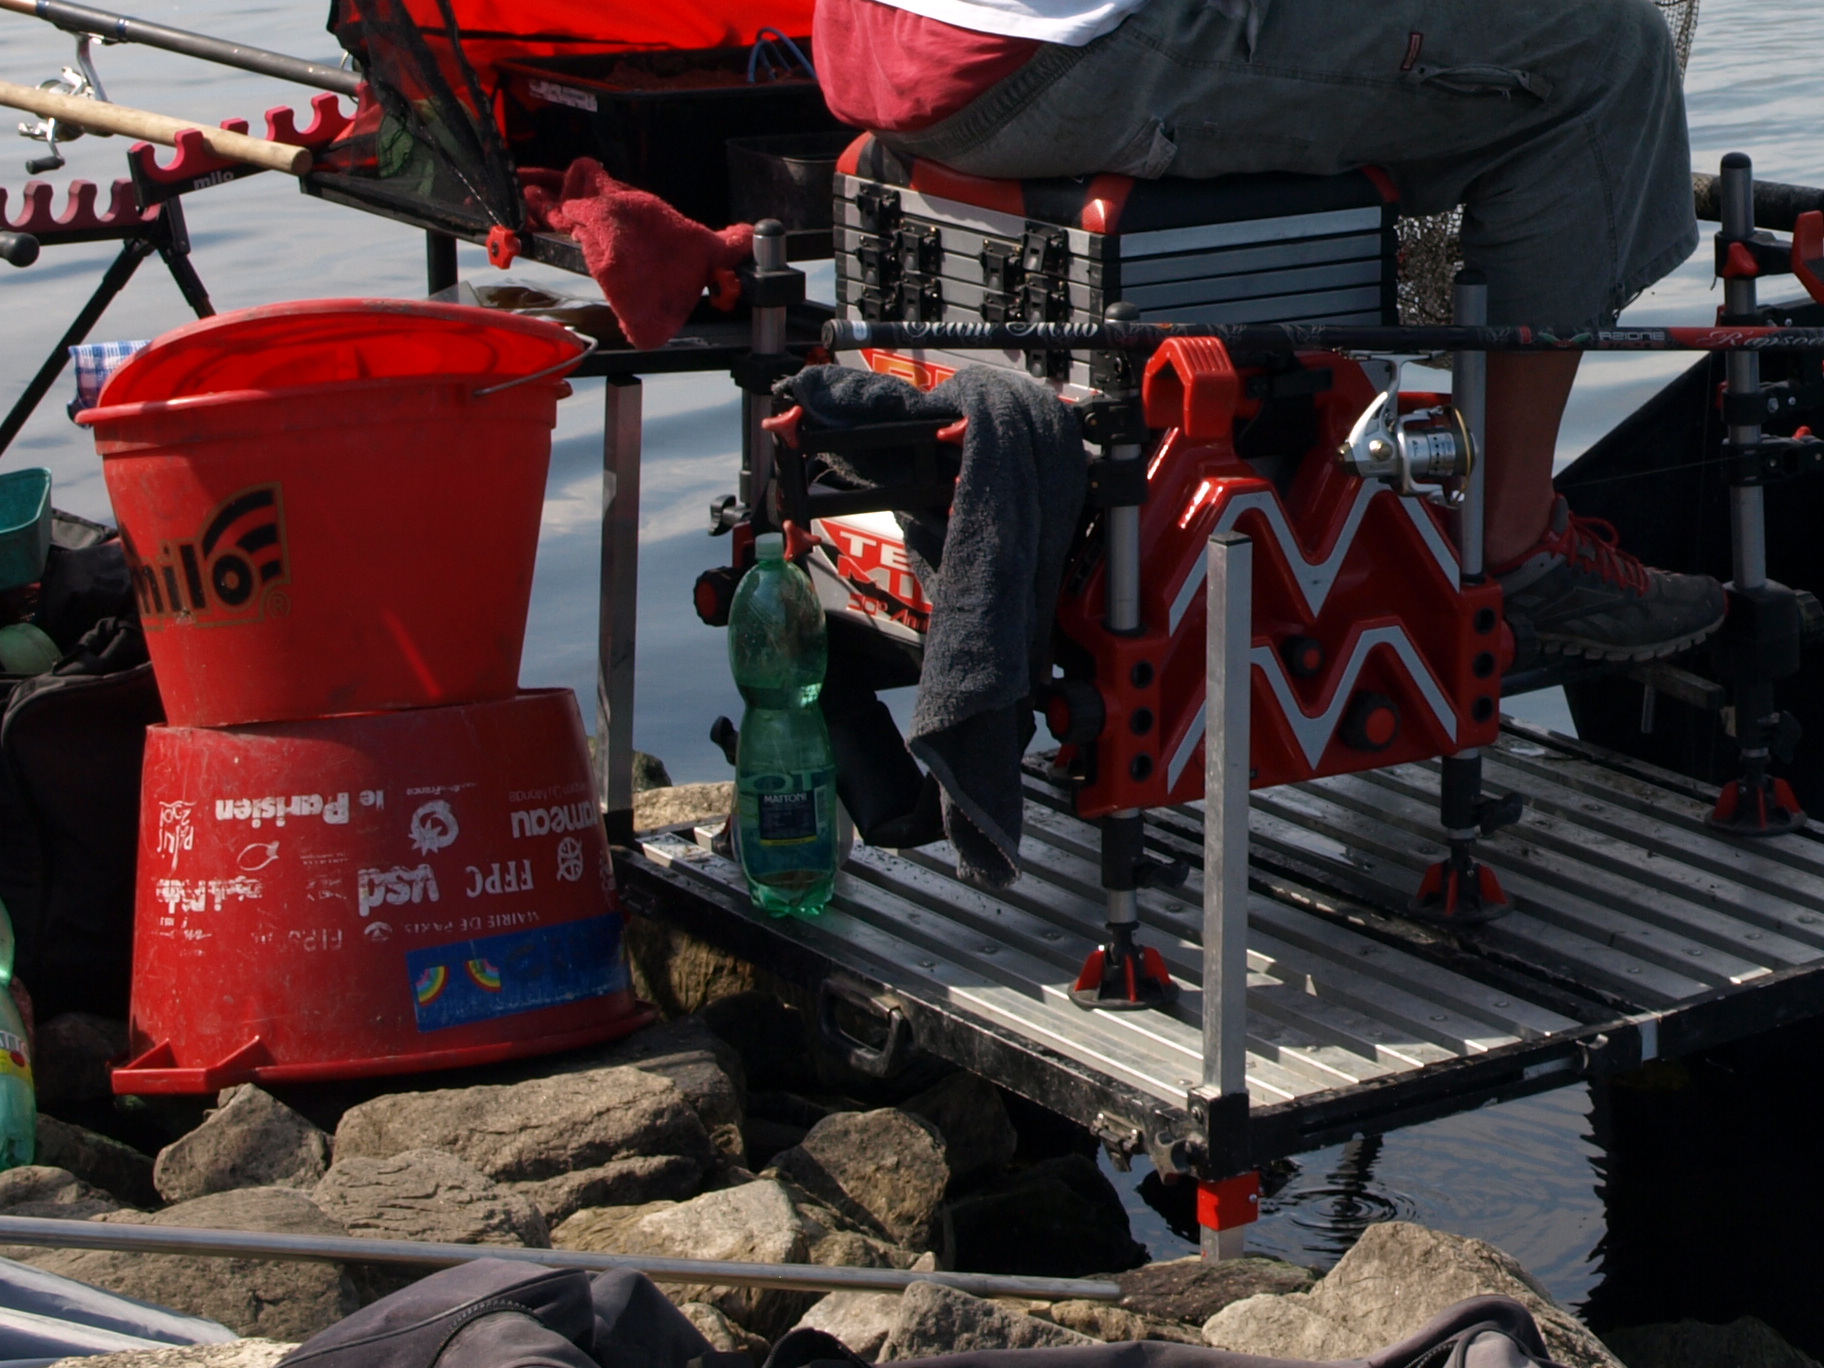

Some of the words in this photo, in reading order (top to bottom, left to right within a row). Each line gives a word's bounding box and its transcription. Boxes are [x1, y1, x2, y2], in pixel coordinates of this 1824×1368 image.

[193, 170, 234, 190] milo
[359, 788, 385, 810] le
[763, 792, 808, 804] MATTONI
[215, 791, 350, 829] Parisien
[465, 858, 535, 899] FFPC
[460, 915, 483, 932] DE
